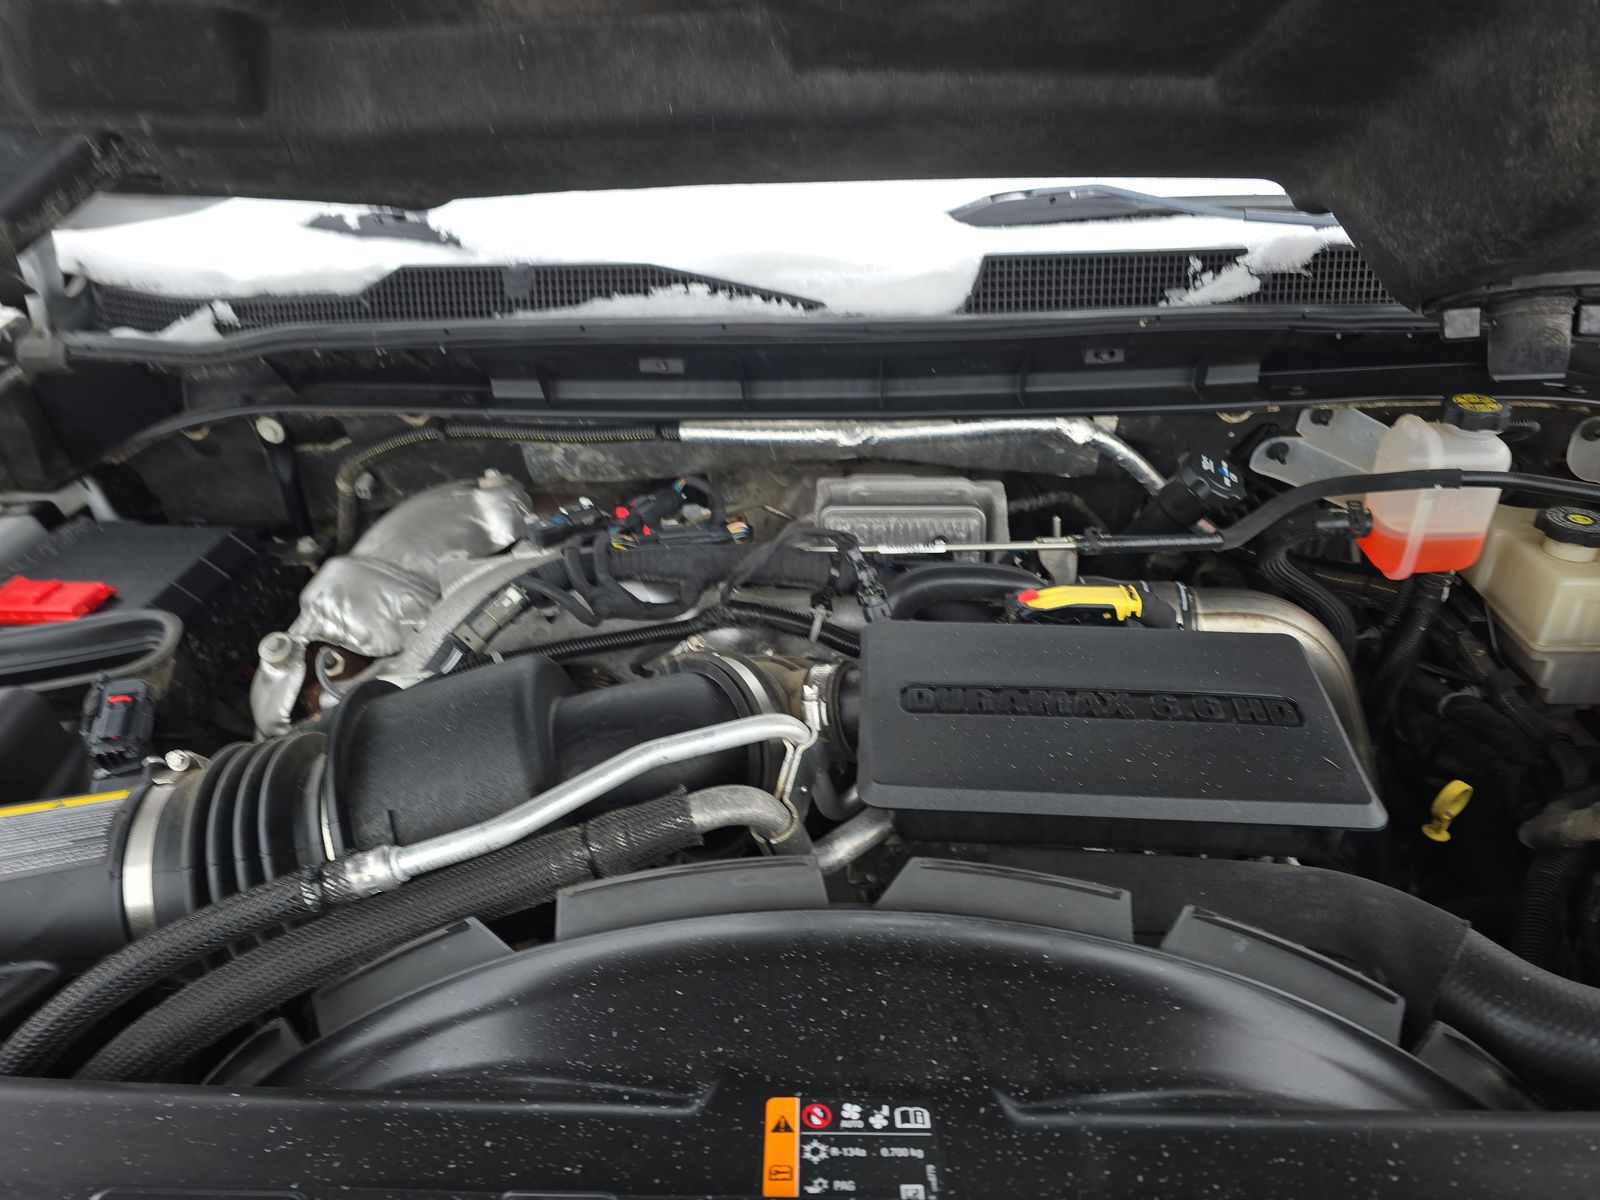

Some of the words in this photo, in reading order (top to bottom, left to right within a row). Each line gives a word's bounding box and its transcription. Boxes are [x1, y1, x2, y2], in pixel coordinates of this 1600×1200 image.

[905, 688, 1134, 717] DURAMAX
[1151, 695, 1225, 719] 6.6
[1231, 698, 1301, 726] HD
